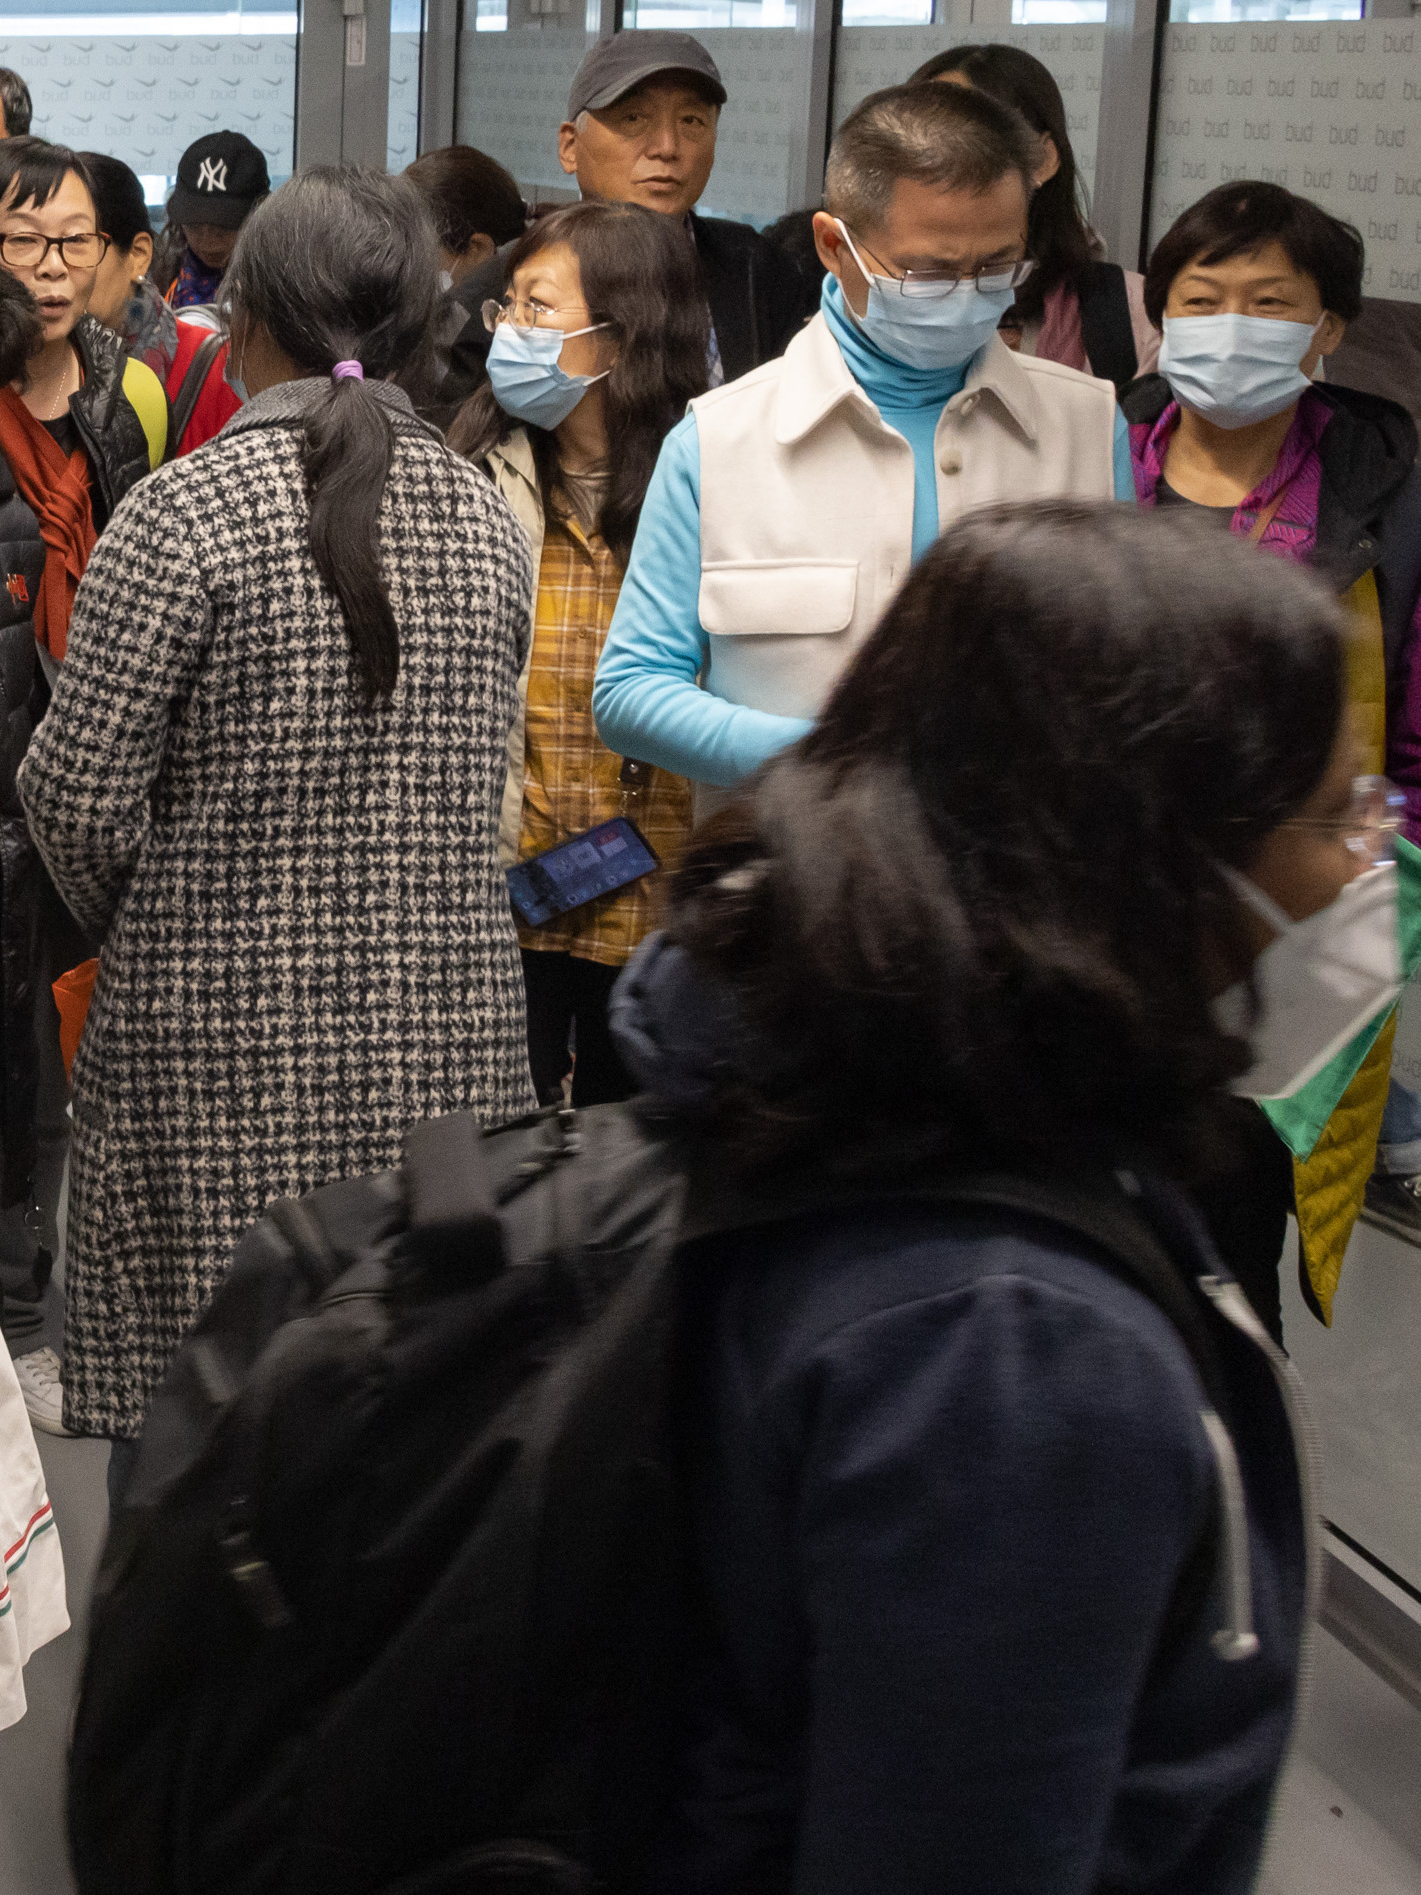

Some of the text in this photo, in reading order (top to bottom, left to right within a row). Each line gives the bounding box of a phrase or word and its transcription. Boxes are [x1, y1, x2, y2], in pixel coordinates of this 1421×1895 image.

[1173, 31, 1414, 53] bud bud bud bud bud bud
[21, 54, 48, 67] bud
[63, 54, 90, 67] bud
[105, 54, 133, 67] bud
[148, 53, 175, 66] bud
[190, 53, 217, 66] bud
[232, 53, 259, 66] bud
[42, 87, 280, 101] bud bud bud bud bud bud
[1188, 76, 1212, 95] bud
[1228, 75, 1252, 96] bud
[1268, 75, 1295, 97] bud
[1311, 76, 1339, 98] bud
[1356, 76, 1386, 99] bud
[1403, 78, 1421, 100] bu
[62, 123, 89, 137] bud
[104, 123, 132, 136] bud
[147, 123, 174, 136] bud
[1166, 118, 1406, 147] bud bud bud bud bud bud
[197, 156, 228, 192] NY
[1182, 159, 1206, 179] bud
[1303, 164, 1332, 189] bud
[1348, 169, 1378, 192] bud
[1368, 218, 1398, 240] bud
[1390, 267, 1420, 290] bud
